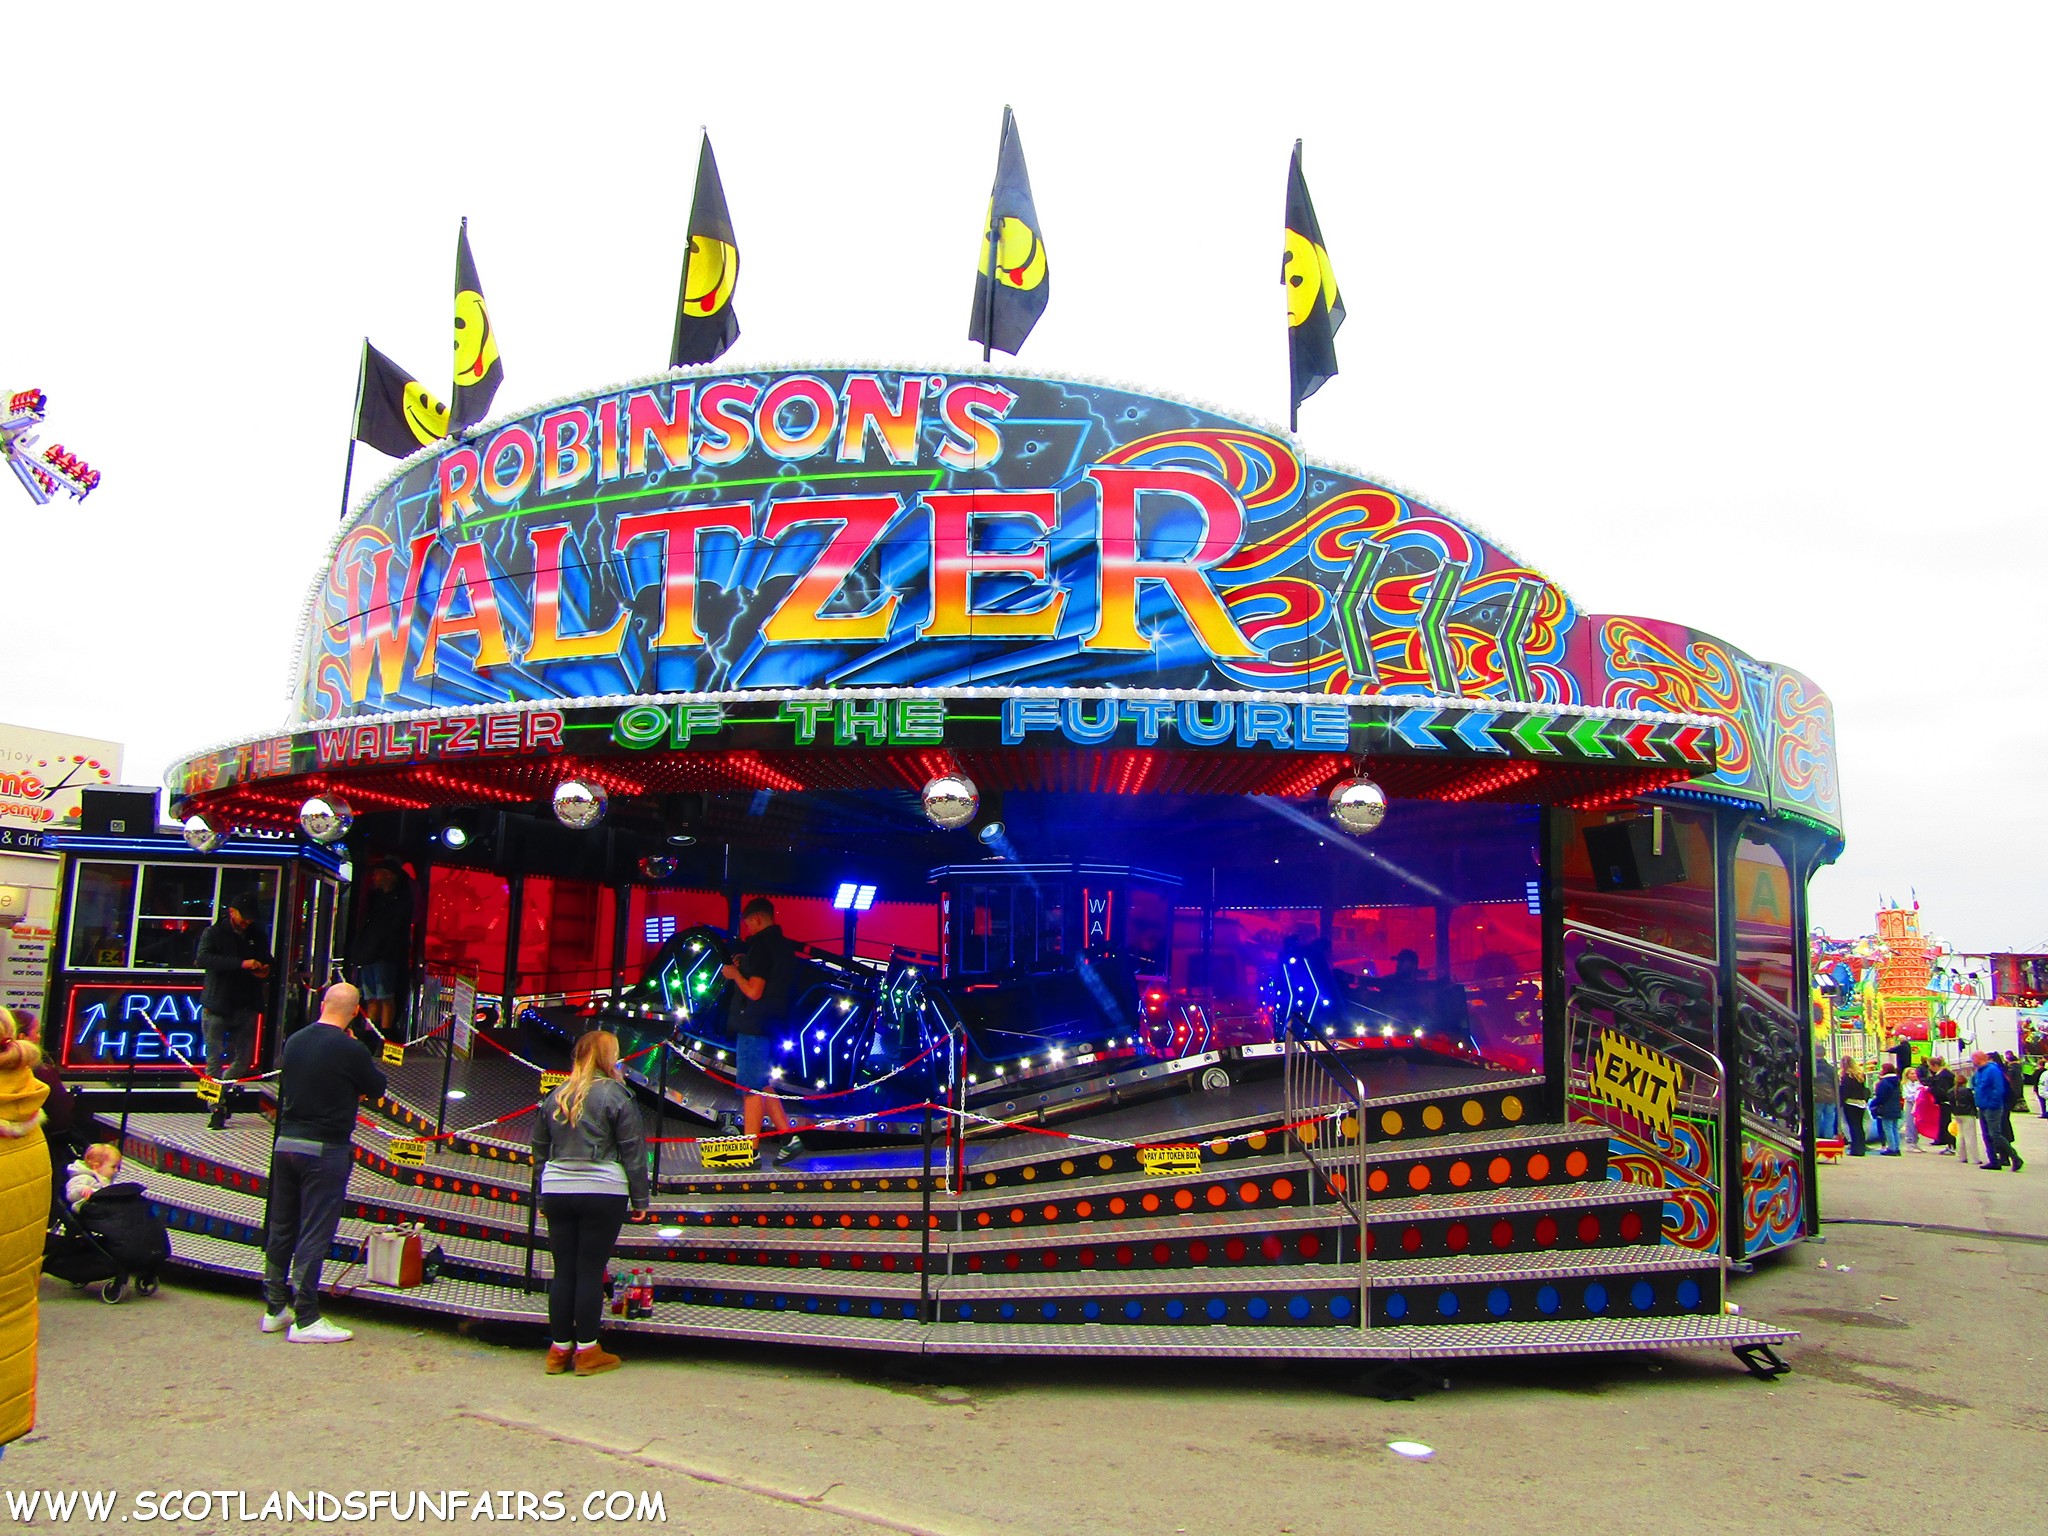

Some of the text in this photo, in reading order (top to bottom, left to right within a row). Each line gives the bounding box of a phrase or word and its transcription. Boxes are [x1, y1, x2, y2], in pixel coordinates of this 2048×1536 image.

[437, 372, 1019, 530] ROBINSON'S
[344, 463, 1269, 704] WALTZER
[237, 736, 292, 782] THE
[315, 709, 564, 768] WALTZER
[613, 703, 722, 749] OF
[779, 699, 945, 745] THE
[1001, 698, 1349, 751] FUTURE
[1089, 898, 1106, 935] WA
[124, 994, 203, 1021] PAY
[98, 1032, 207, 1058] HER
[1604, 1053, 1668, 1104] EXIT
[704, 1142, 749, 1153] PAY AT TOKEN BOX
[1147, 1151, 1197, 1160] PAY AT TOKEN BOX
